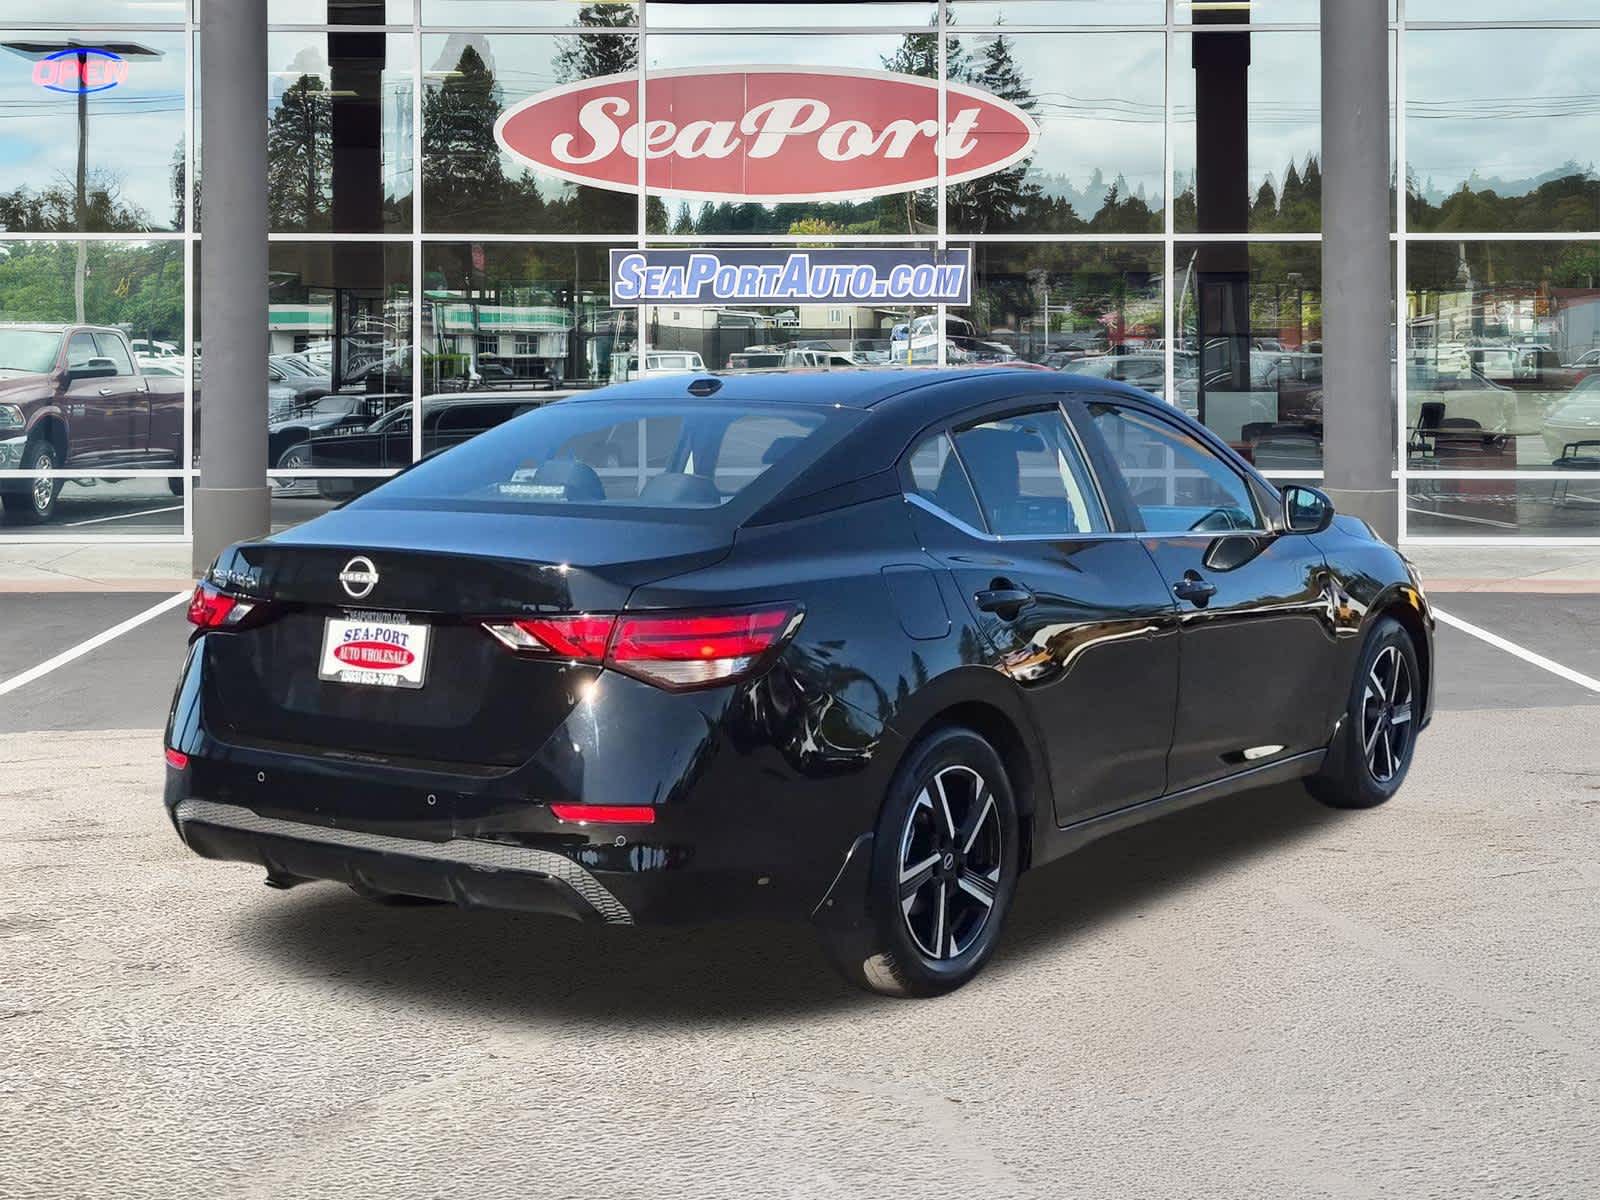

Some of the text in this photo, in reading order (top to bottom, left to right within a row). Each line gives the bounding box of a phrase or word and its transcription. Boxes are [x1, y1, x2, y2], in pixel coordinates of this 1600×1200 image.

[32, 58, 129, 86] OPEN
[551, 96, 982, 164] SeaPort
[340, 572, 380, 584] NISSAN
[343, 627, 409, 646] SEA-PORT
[339, 646, 409, 664] AUTO WHOLESALE
